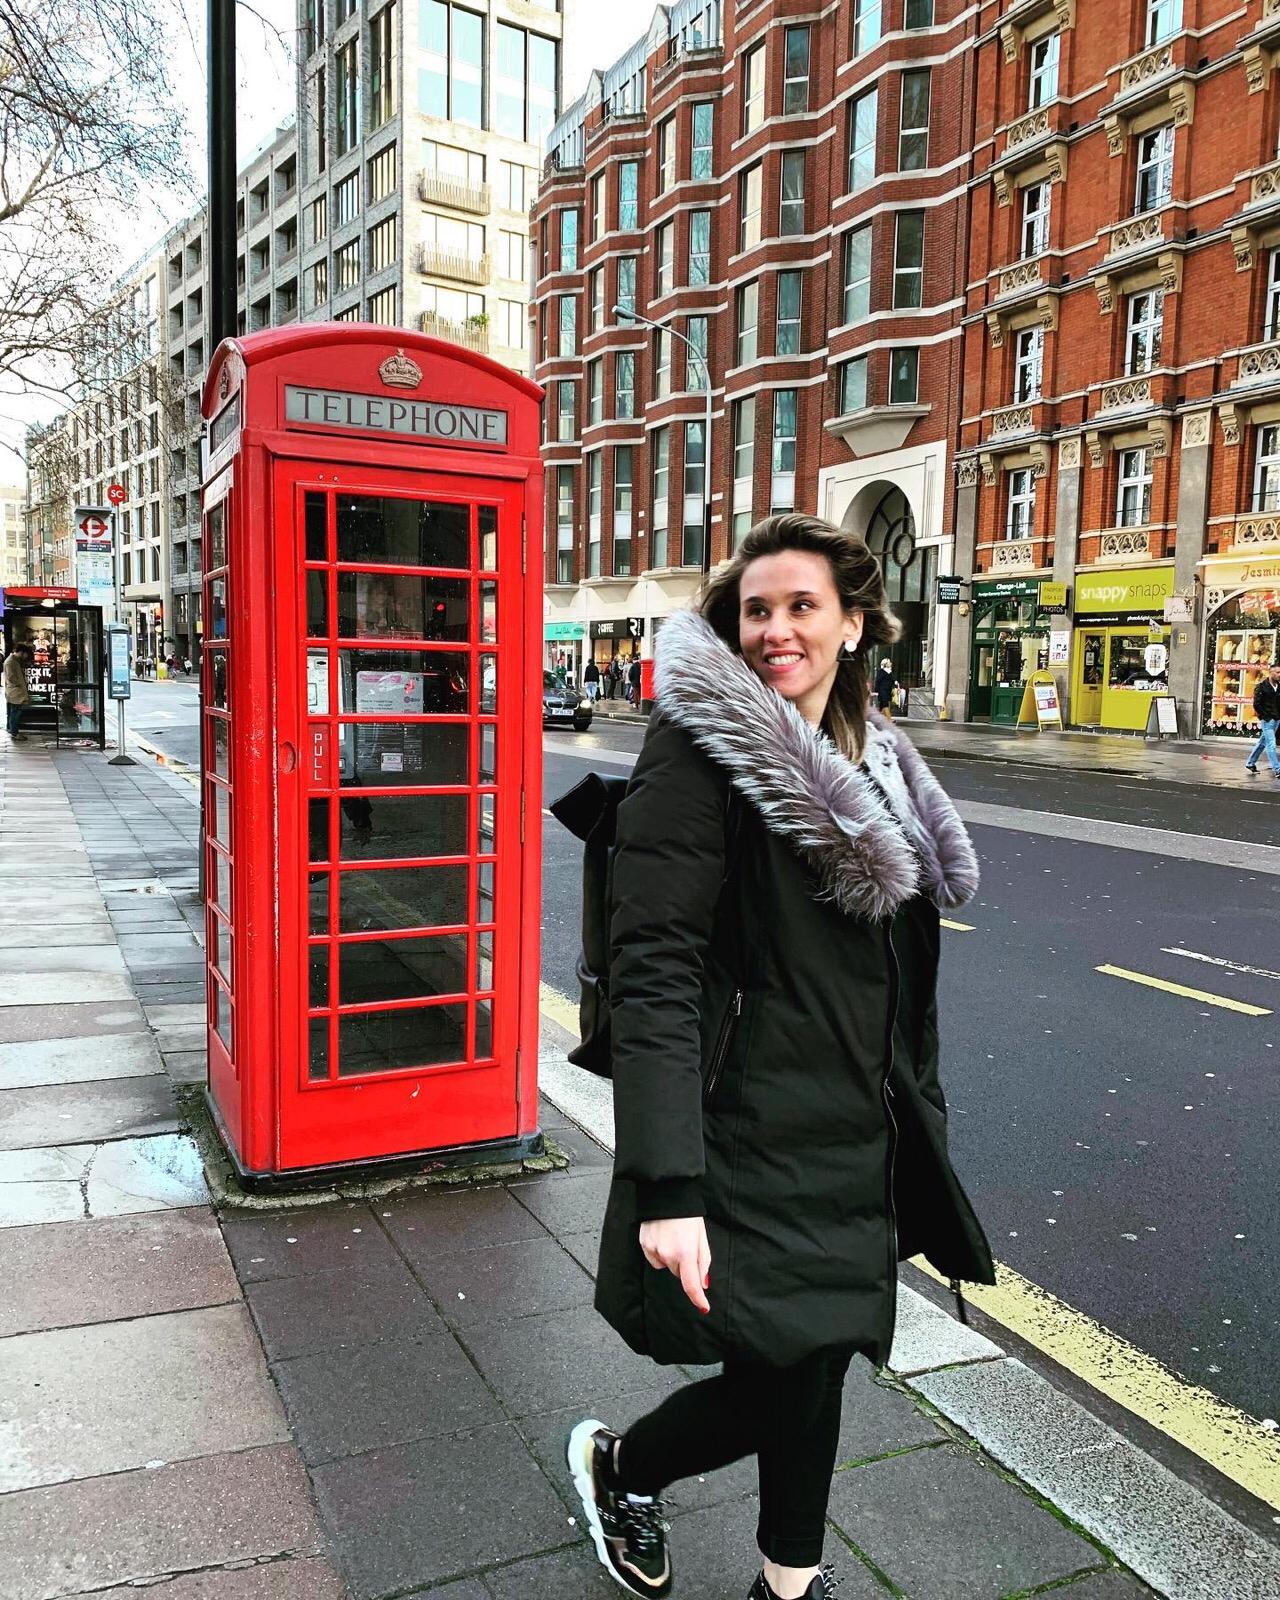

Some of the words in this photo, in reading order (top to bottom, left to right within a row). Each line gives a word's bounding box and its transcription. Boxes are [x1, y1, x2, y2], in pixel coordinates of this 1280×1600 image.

[296, 391, 498, 441] TELEPHONE
[110, 489, 124, 499] SC
[996, 582, 1027, 590] Change-Link
[1080, 586, 1128, 604] snappy
[1129, 583, 1167, 602] snaps
[47, 683, 57, 692] IT
[314, 733, 323, 781] PULL
